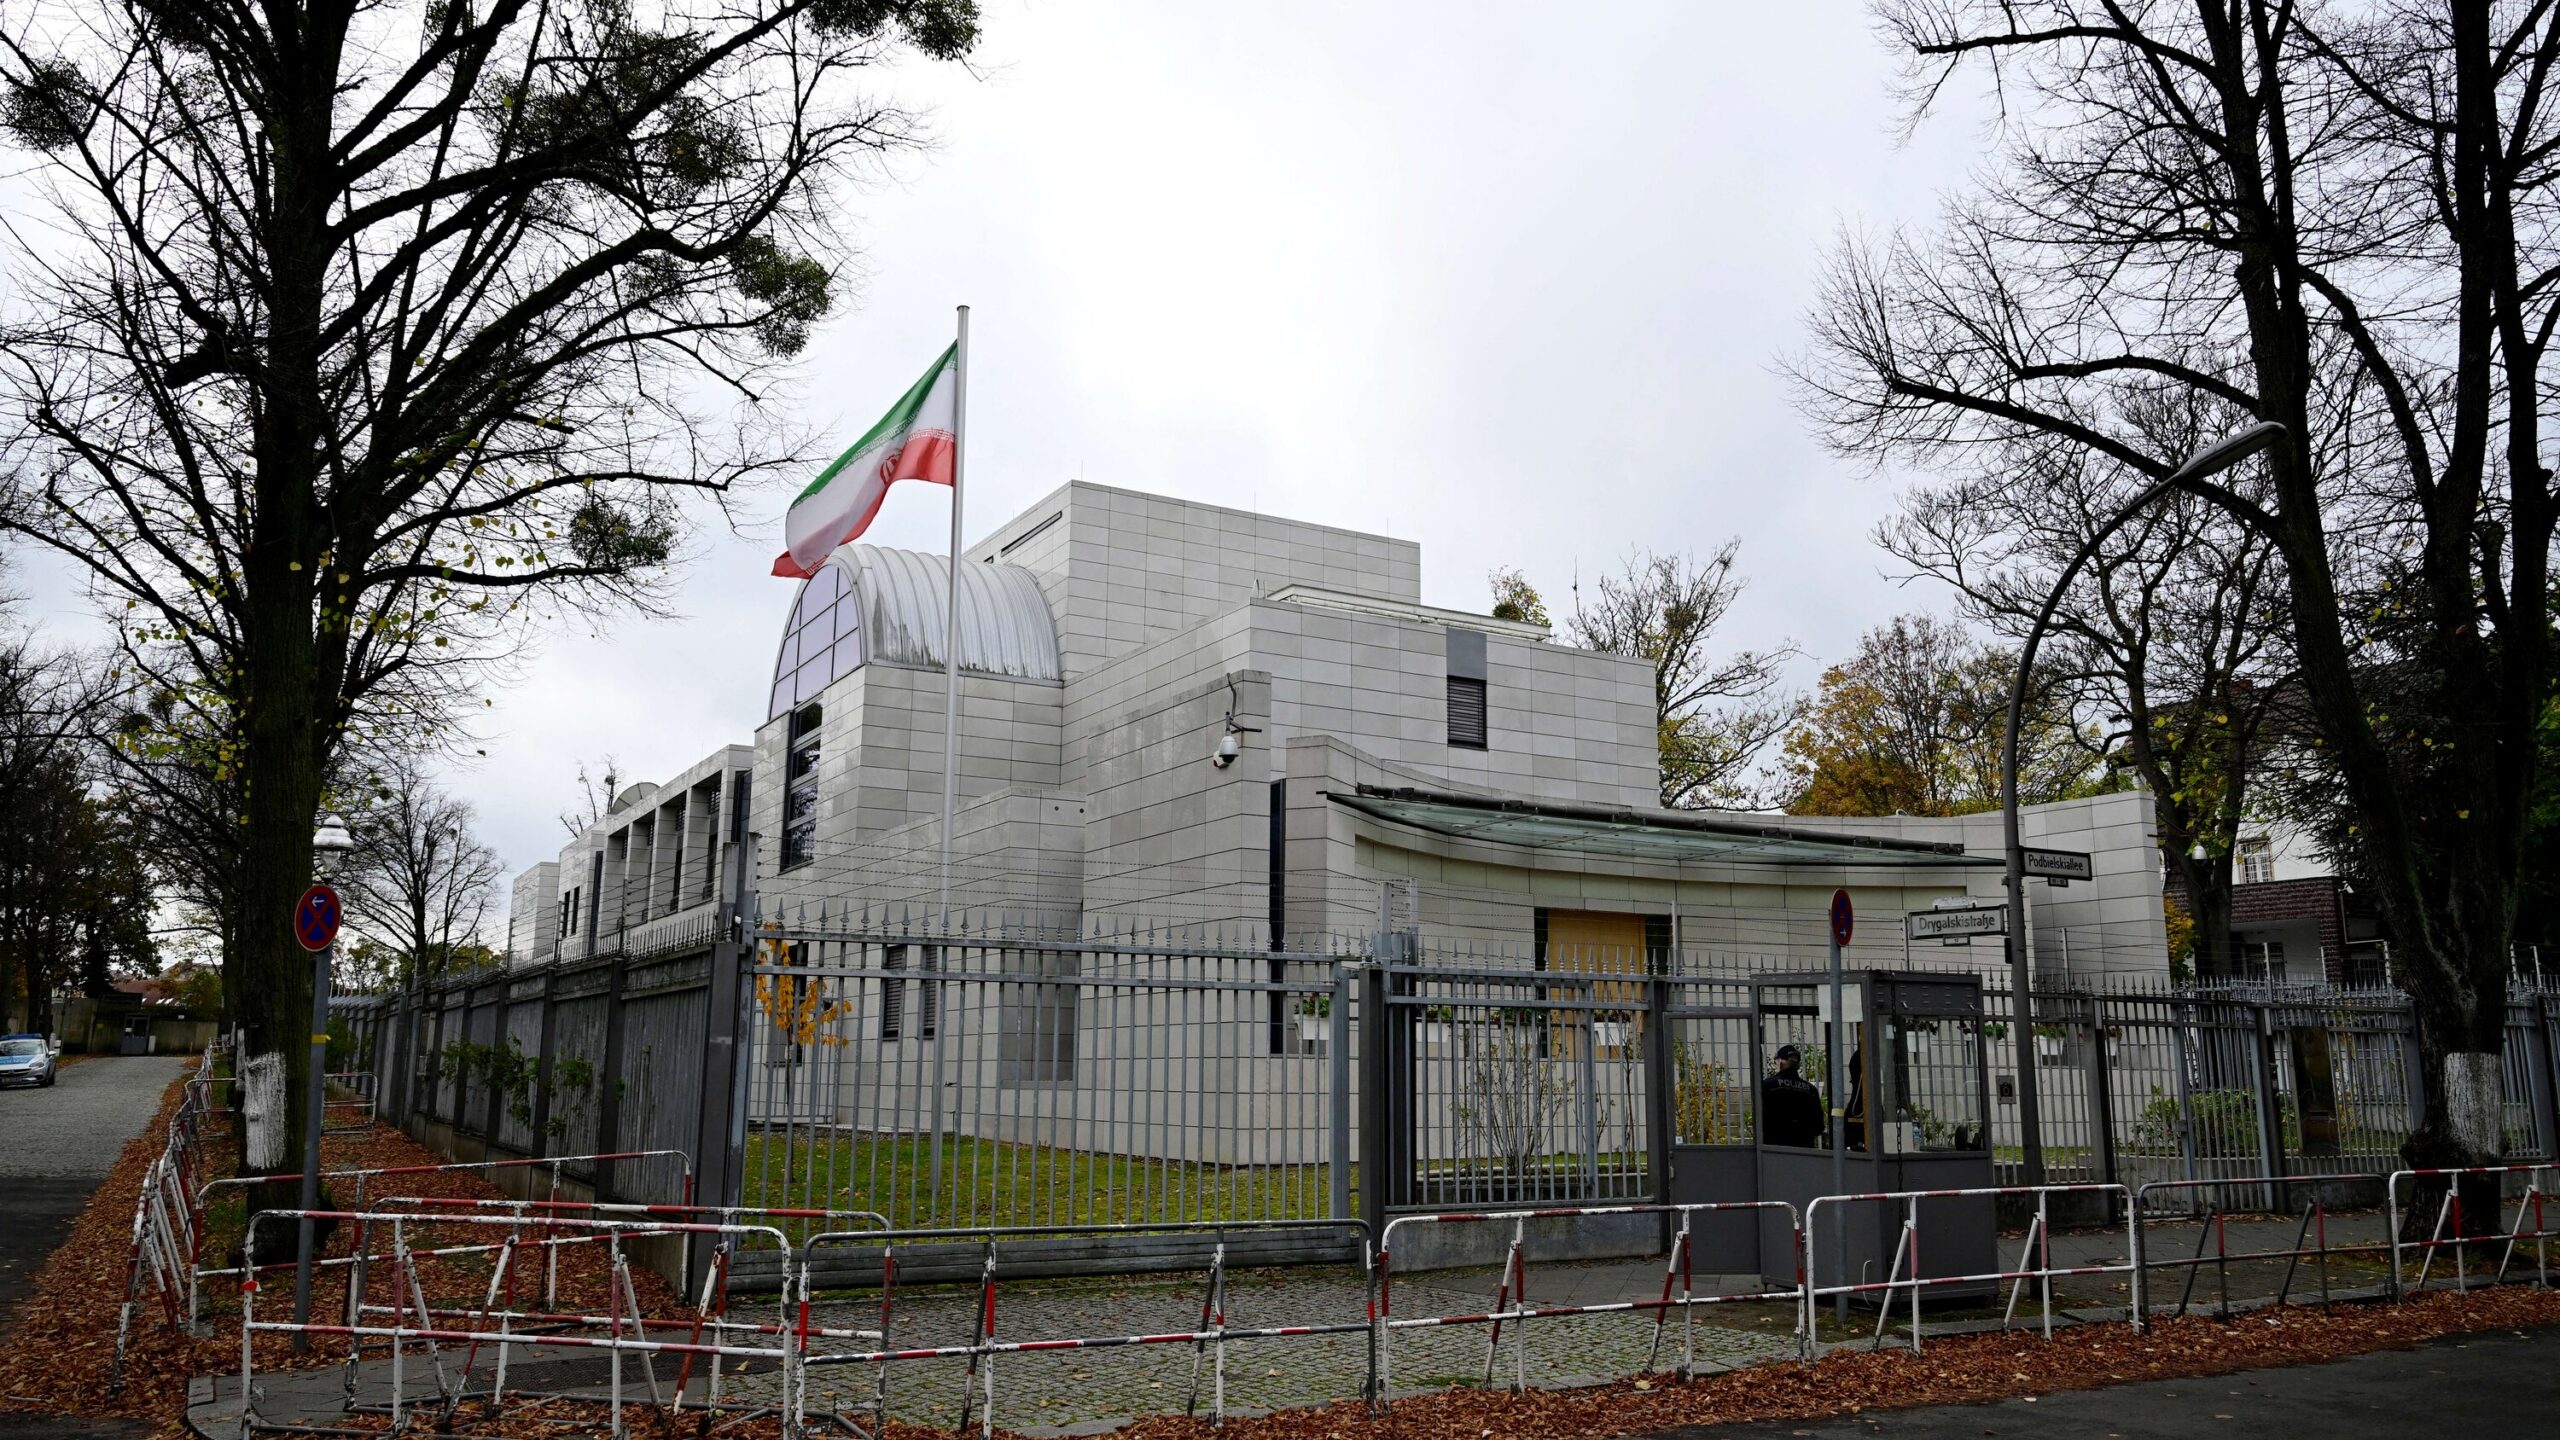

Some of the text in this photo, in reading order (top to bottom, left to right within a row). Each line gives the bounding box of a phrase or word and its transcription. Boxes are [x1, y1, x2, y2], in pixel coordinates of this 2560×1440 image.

[2028, 854, 2084, 871] Podbielskiallee
[1918, 913, 1995, 932] Drygalskistraße
[1777, 1079, 1810, 1091] POLIZEI
